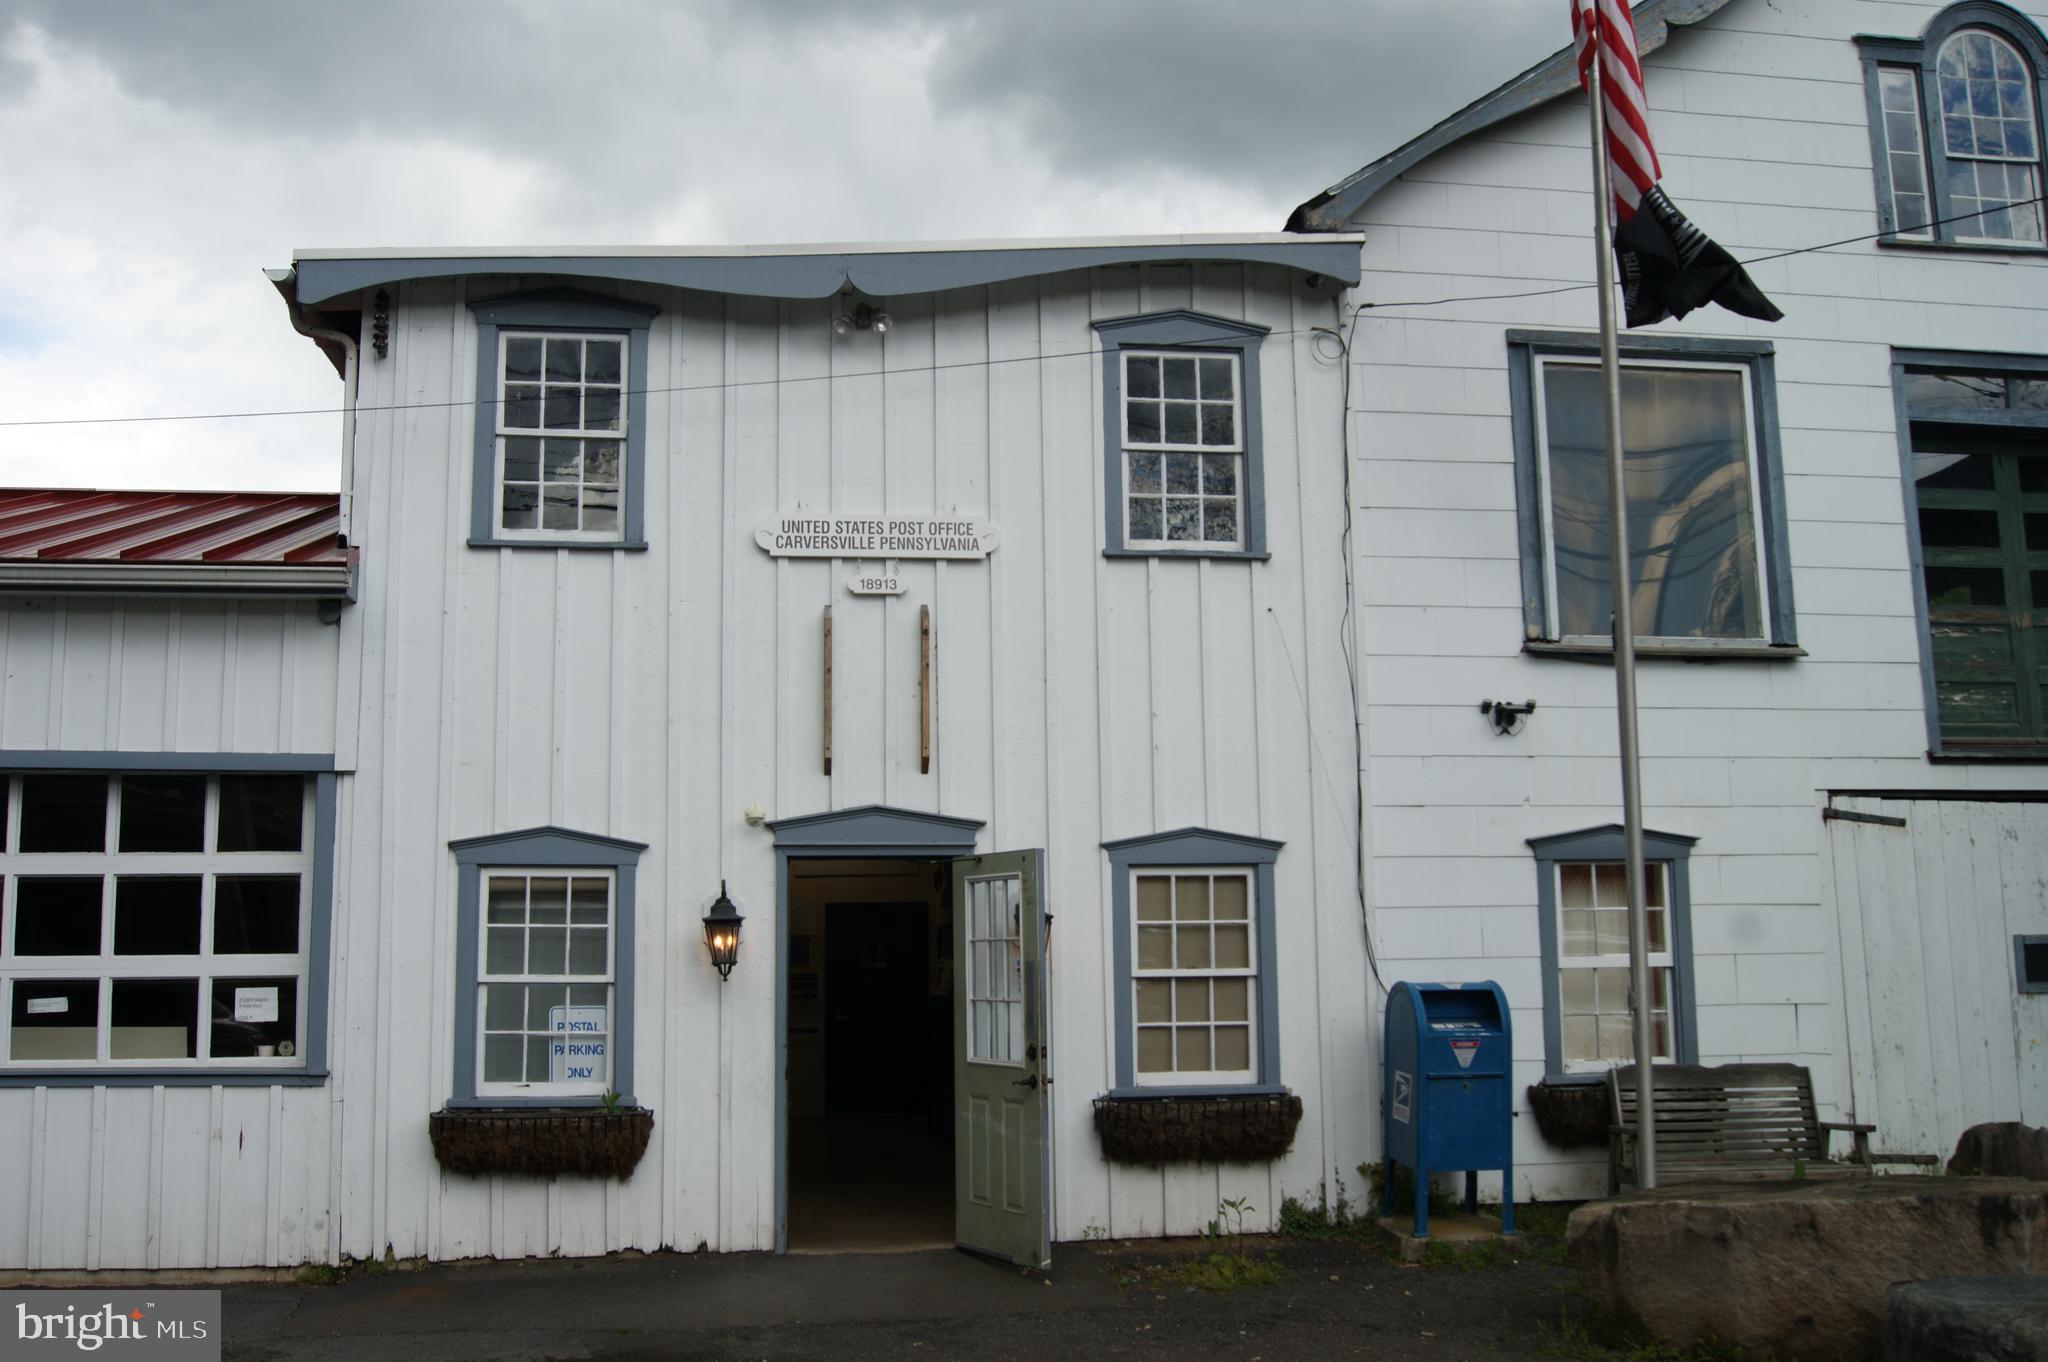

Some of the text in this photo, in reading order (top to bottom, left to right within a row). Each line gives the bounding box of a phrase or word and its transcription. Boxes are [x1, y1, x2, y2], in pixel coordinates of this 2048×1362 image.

[781, 520, 974, 536] UNITED STATES POST OFFICE
[775, 535, 979, 551] CARVERSVILLE PENNSYLVANIA
[859, 579, 897, 590] 18913
